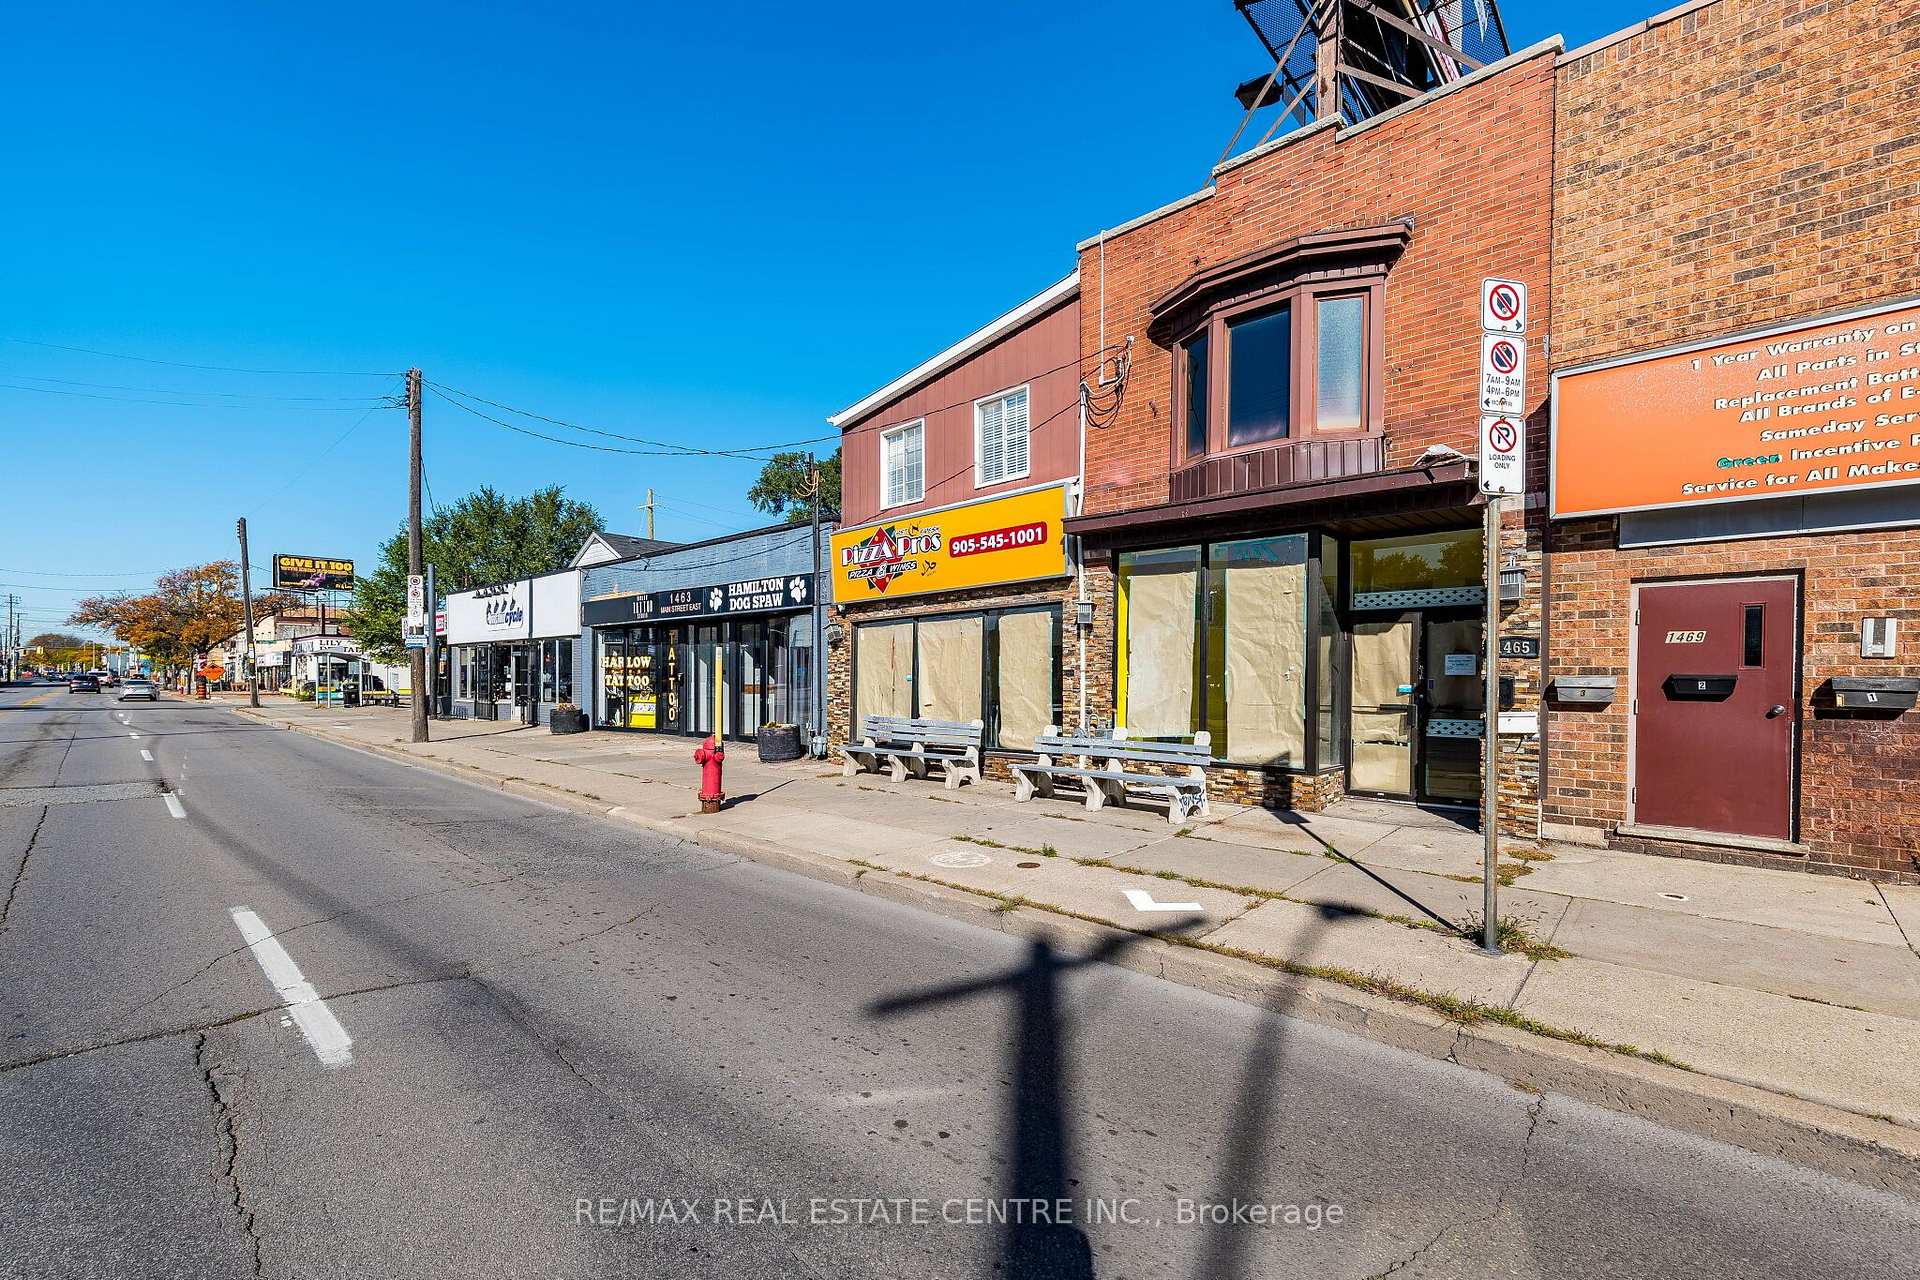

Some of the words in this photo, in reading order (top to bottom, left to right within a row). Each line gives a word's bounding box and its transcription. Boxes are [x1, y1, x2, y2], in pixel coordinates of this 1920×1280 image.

[1691, 359, 1702, 371] 1
[1711, 350, 1760, 367] Year
[1766, 328, 1877, 357] Warranty
[1885, 321, 1916, 335] on
[1757, 364, 1788, 381] All
[1796, 356, 1857, 375] Parts
[1866, 349, 1890, 363] in
[1714, 377, 1858, 410] Replacement
[1867, 367, 1920, 386] Batt
[1739, 407, 1770, 423] All
[1777, 396, 1857, 418] Brands
[1866, 388, 1892, 404] of
[1901, 386, 1920, 400] E-
[1760, 419, 1866, 441] Sameday
[1875, 411, 1920, 427] Ser
[1717, 453, 1782, 469] Green
[1791, 439, 1901, 461] Incentive
[1682, 478, 1759, 495] Service
[1765, 473, 1799, 486] for
[1806, 466, 1839, 482] All
[1847, 460, 1920, 478] Make
[952, 527, 1042, 554] 905-545-1001
[280, 557, 313, 568] GIVE
[315, 561, 327, 569] IT
[329, 562, 353, 571] 100
[849, 568, 873, 579] PIZZA
[890, 562, 917, 572] WINGS
[670, 591, 691, 604] 1463
[728, 578, 784, 596] HAMILTON
[671, 604, 689, 613] STREET
[689, 602, 702, 611] EAST
[729, 597, 750, 610] DOG
[752, 593, 783, 609] SPAW
[1500, 641, 1530, 654] 465
[1669, 632, 1704, 642] 1469
[668, 630, 676, 721] TATTOO
